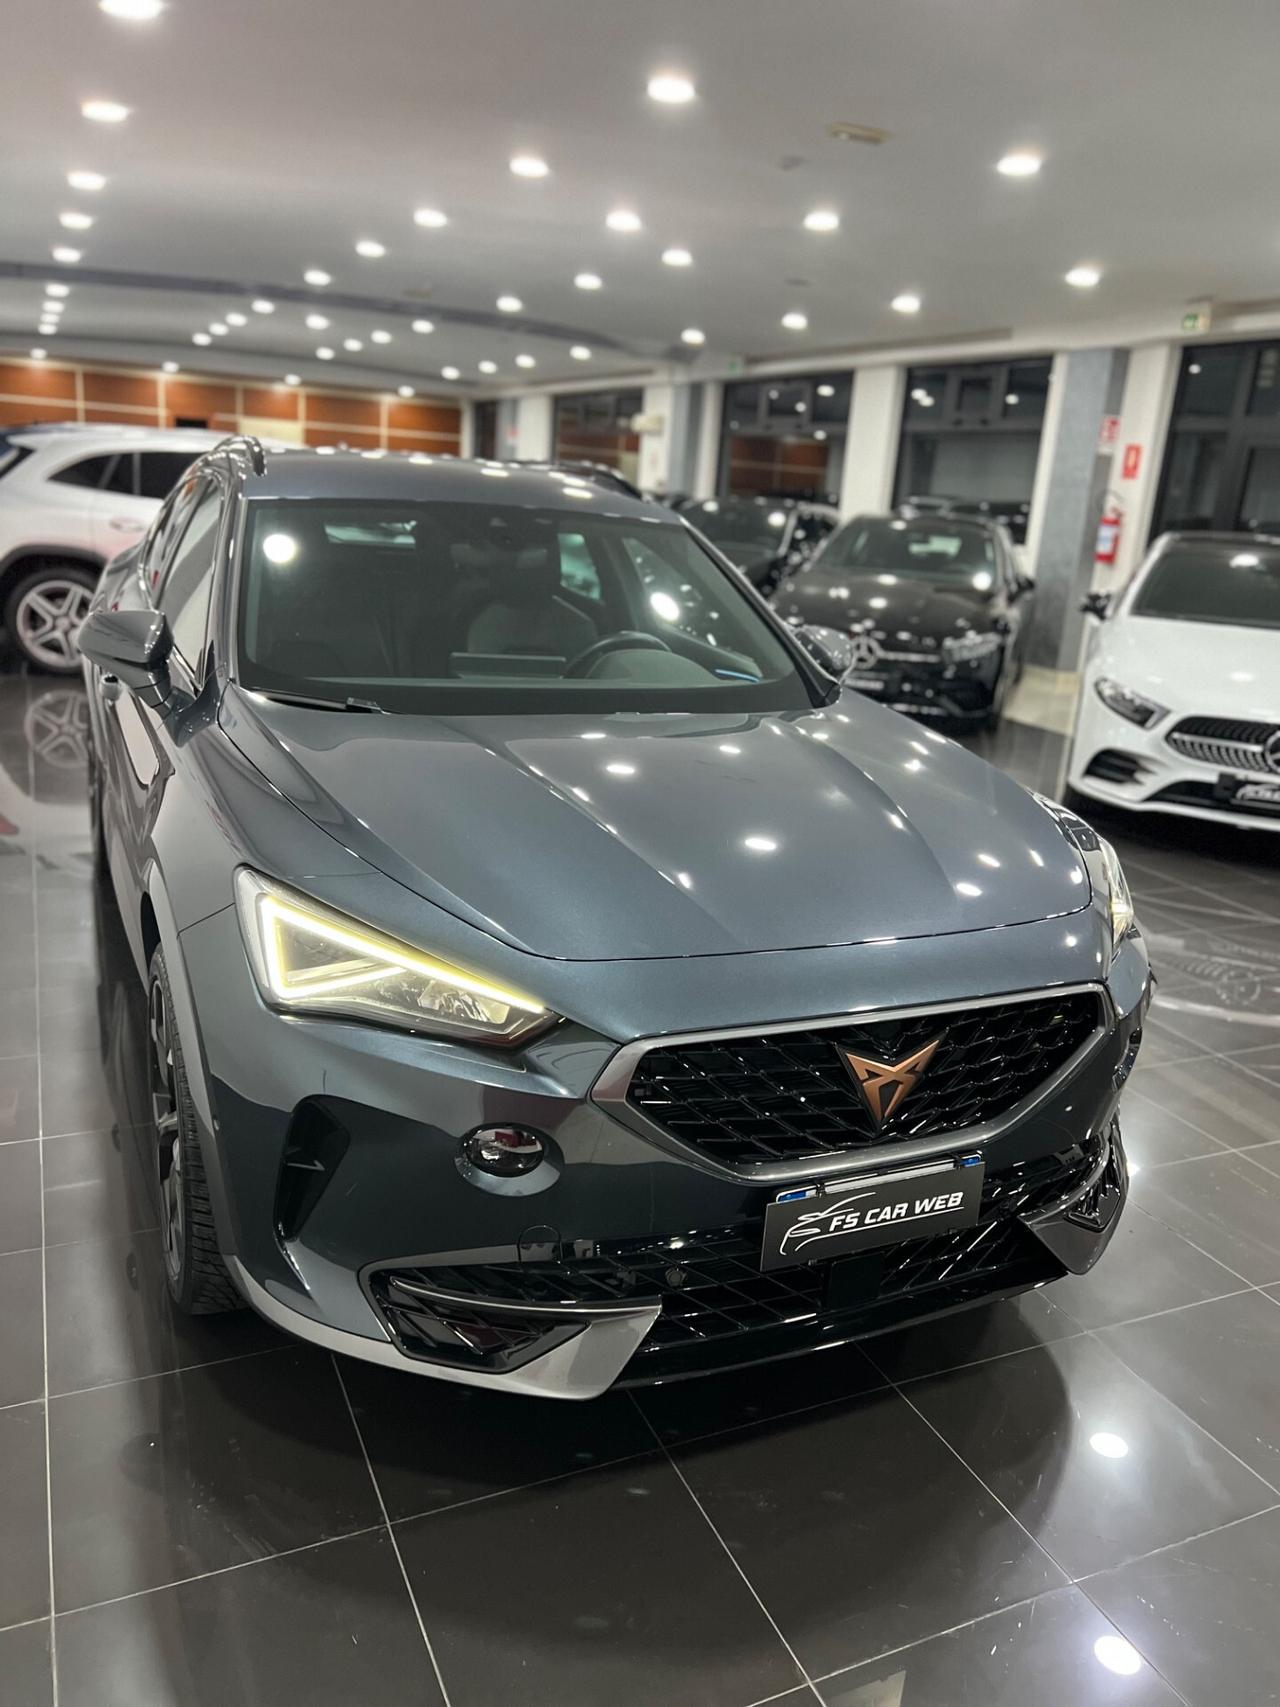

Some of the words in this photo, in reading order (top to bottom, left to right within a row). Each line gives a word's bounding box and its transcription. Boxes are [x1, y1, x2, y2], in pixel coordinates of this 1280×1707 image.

[829, 1212, 861, 1232] FS
[864, 1203, 908, 1224] CAR
[914, 1192, 964, 1214] WEB
